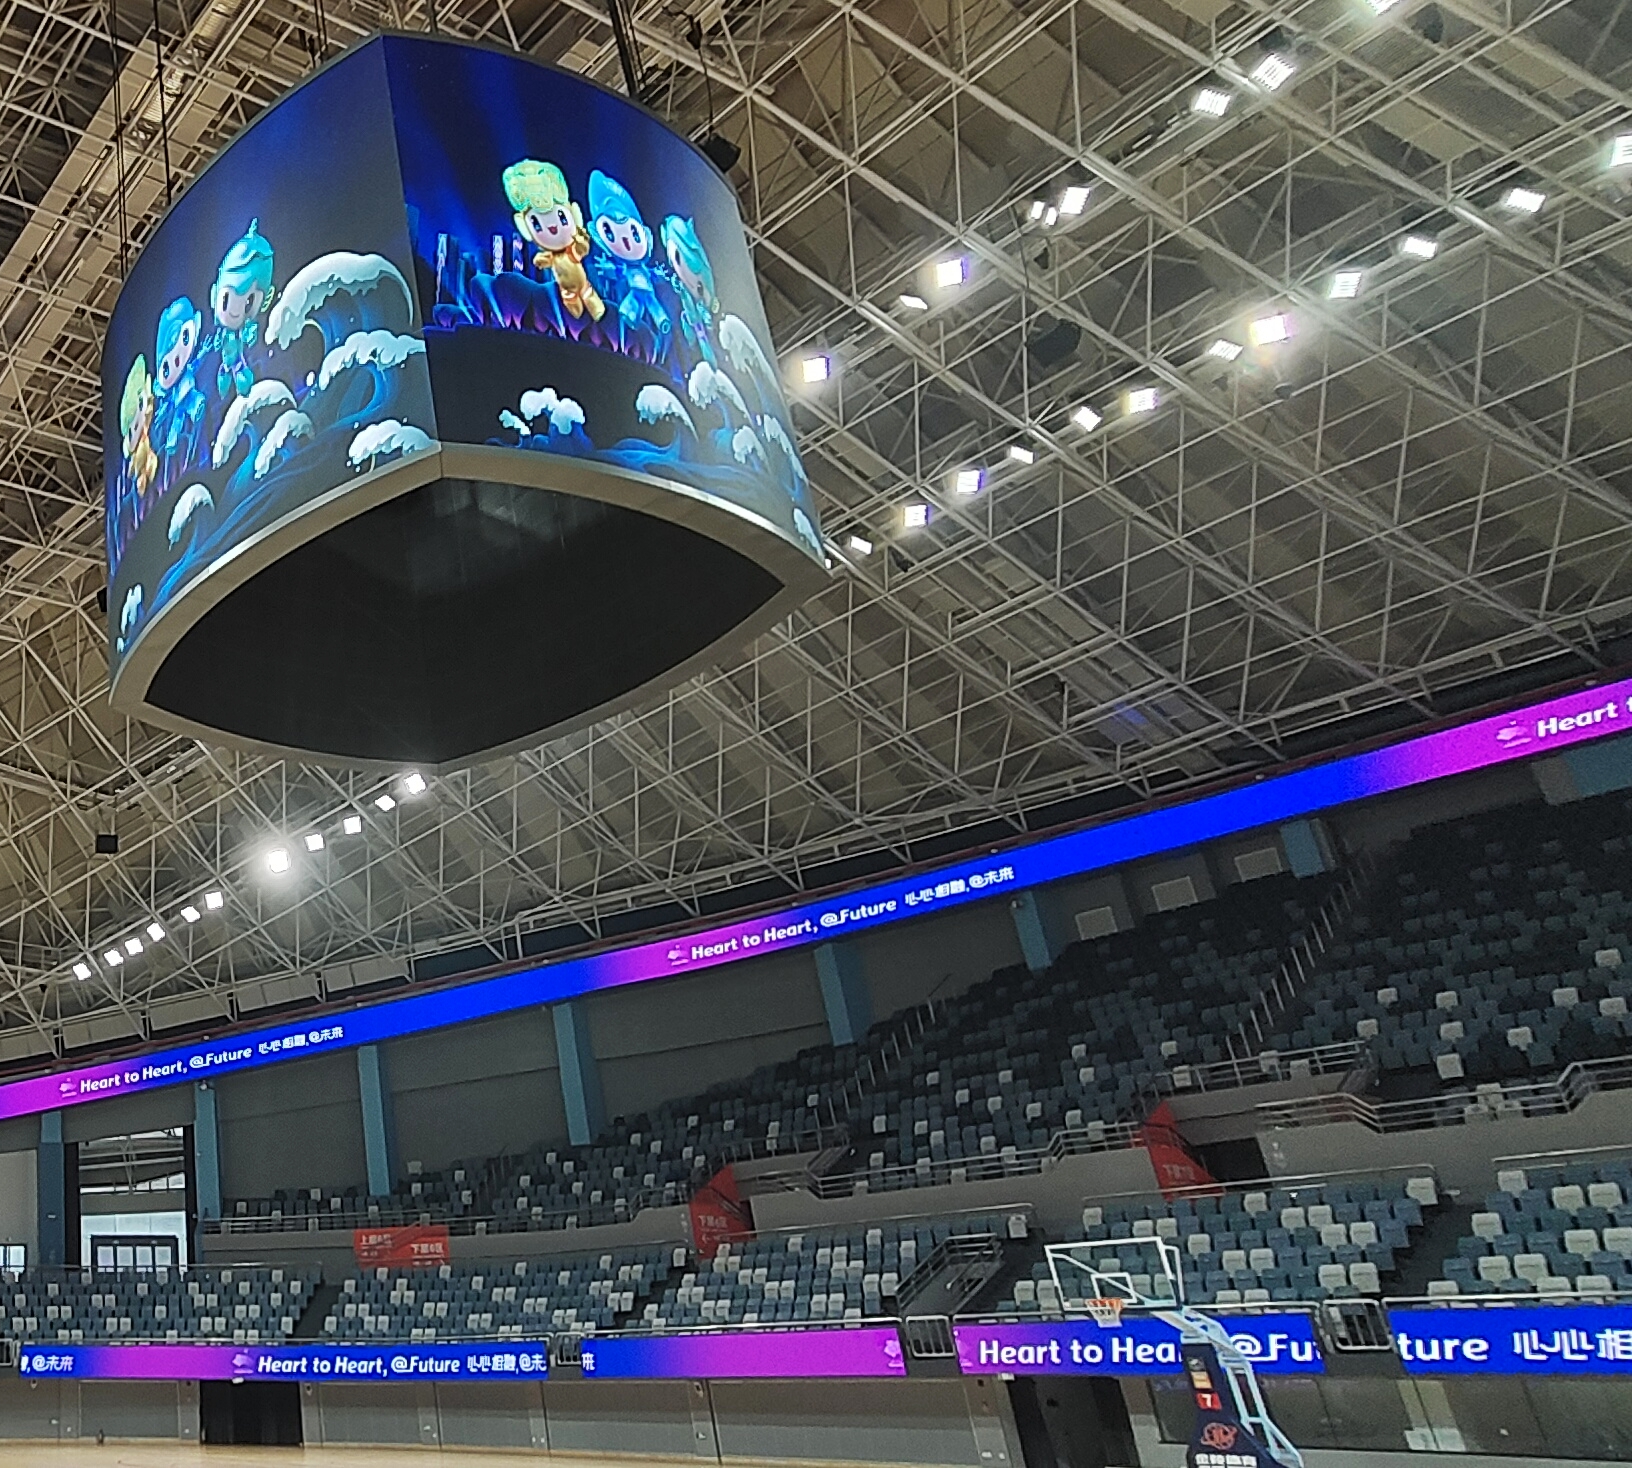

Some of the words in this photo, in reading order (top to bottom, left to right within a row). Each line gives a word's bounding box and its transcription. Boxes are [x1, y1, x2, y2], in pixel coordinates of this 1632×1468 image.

[1537, 701, 1619, 737] Heart
[691, 938, 738, 960] Heart
[742, 933, 760, 948] to
[764, 919, 818, 944] Heart,
[820, 900, 897, 928] @Future
[80, 1074, 121, 1094] Heart
[124, 1071, 139, 1084] to
[142, 1060, 187, 1080] Heart,
[190, 1047, 253, 1069] @Future
[979, 1339, 1062, 1364] Heart
[1069, 1339, 1103, 1364] to
[1111, 1336, 1182, 1363] Hea
[1230, 1333, 1321, 1362] @Fu
[1397, 1332, 1489, 1361] ture
[257, 1355, 308, 1373] Heart
[312, 1356, 331, 1374] to
[334, 1355, 387, 1377] Heart,
[390, 1355, 461, 1374] @Future
